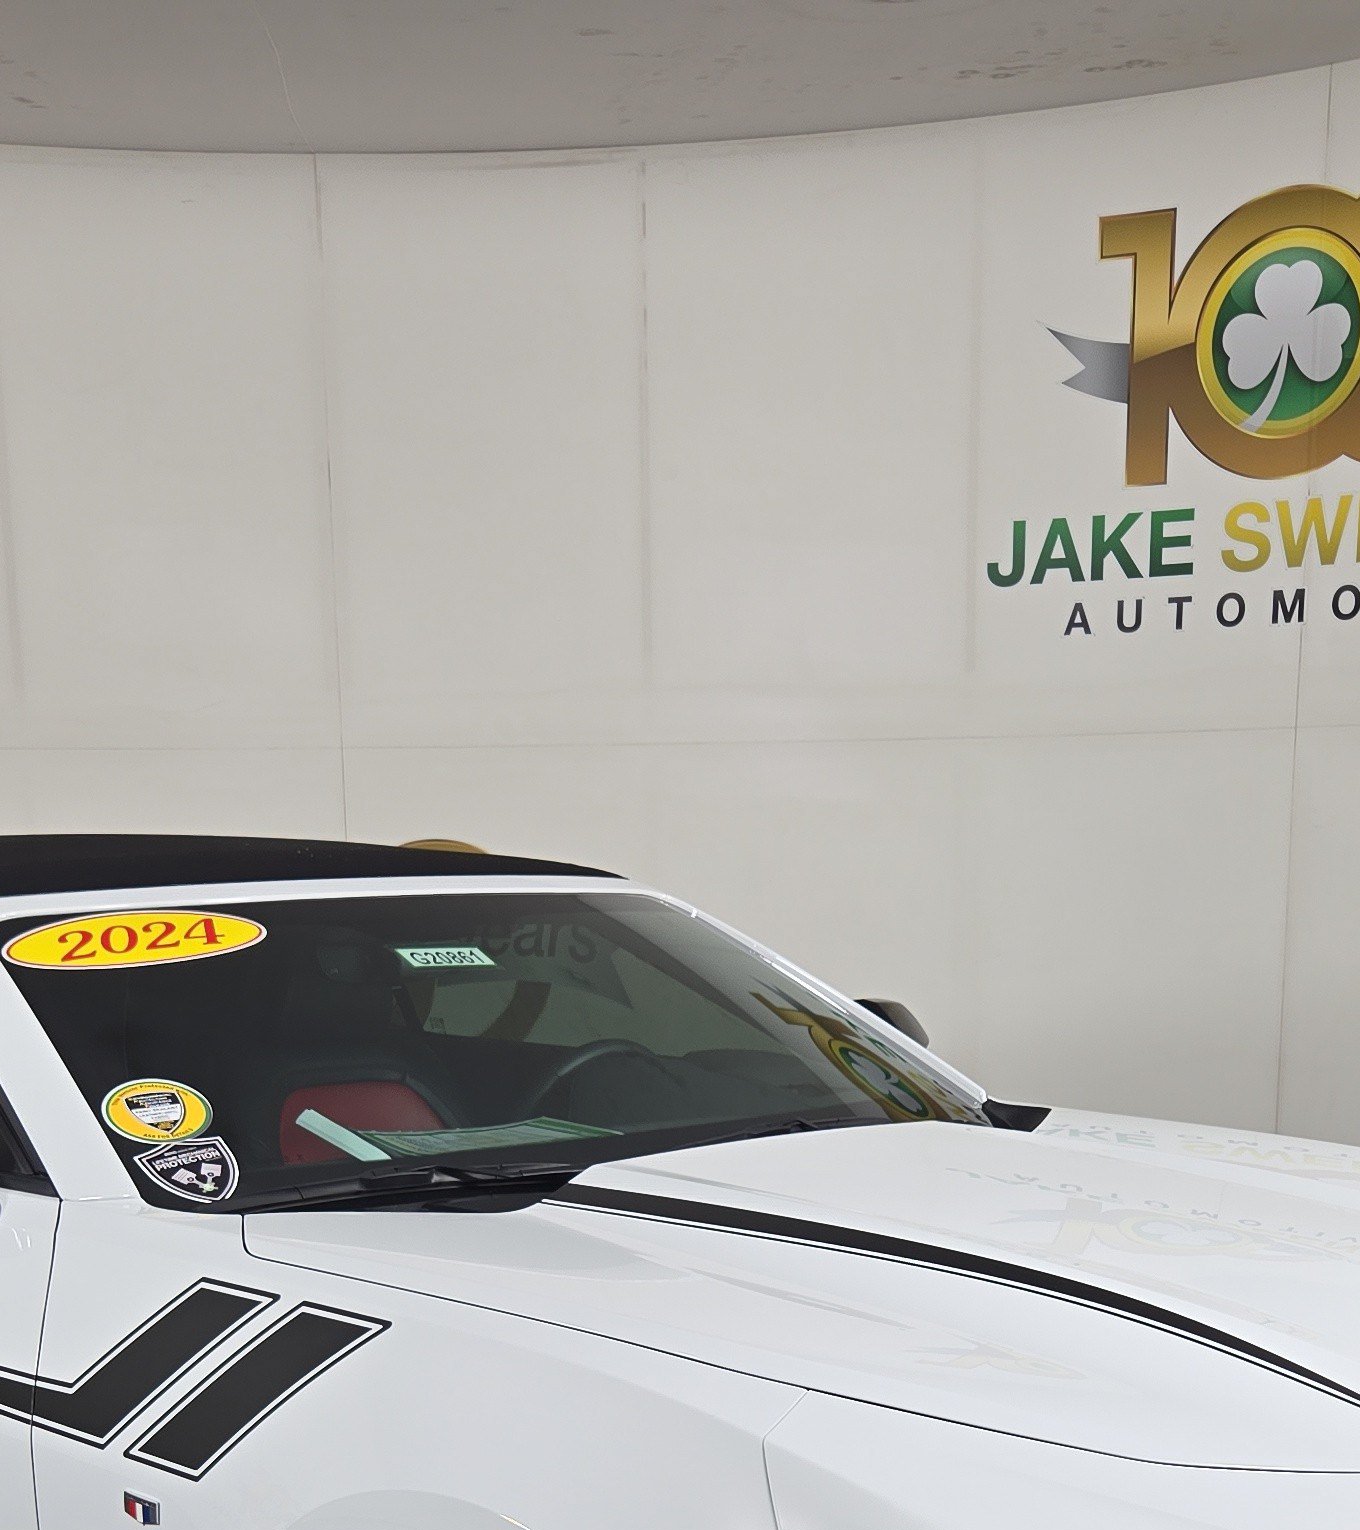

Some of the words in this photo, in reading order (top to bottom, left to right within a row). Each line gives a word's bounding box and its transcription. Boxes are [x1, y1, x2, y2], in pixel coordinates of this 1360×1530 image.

[986, 507, 1197, 588] JAKE
[56, 917, 226, 963] 2024
[409, 949, 486, 966] G20861
[154, 1150, 221, 1172] PROTECTION
